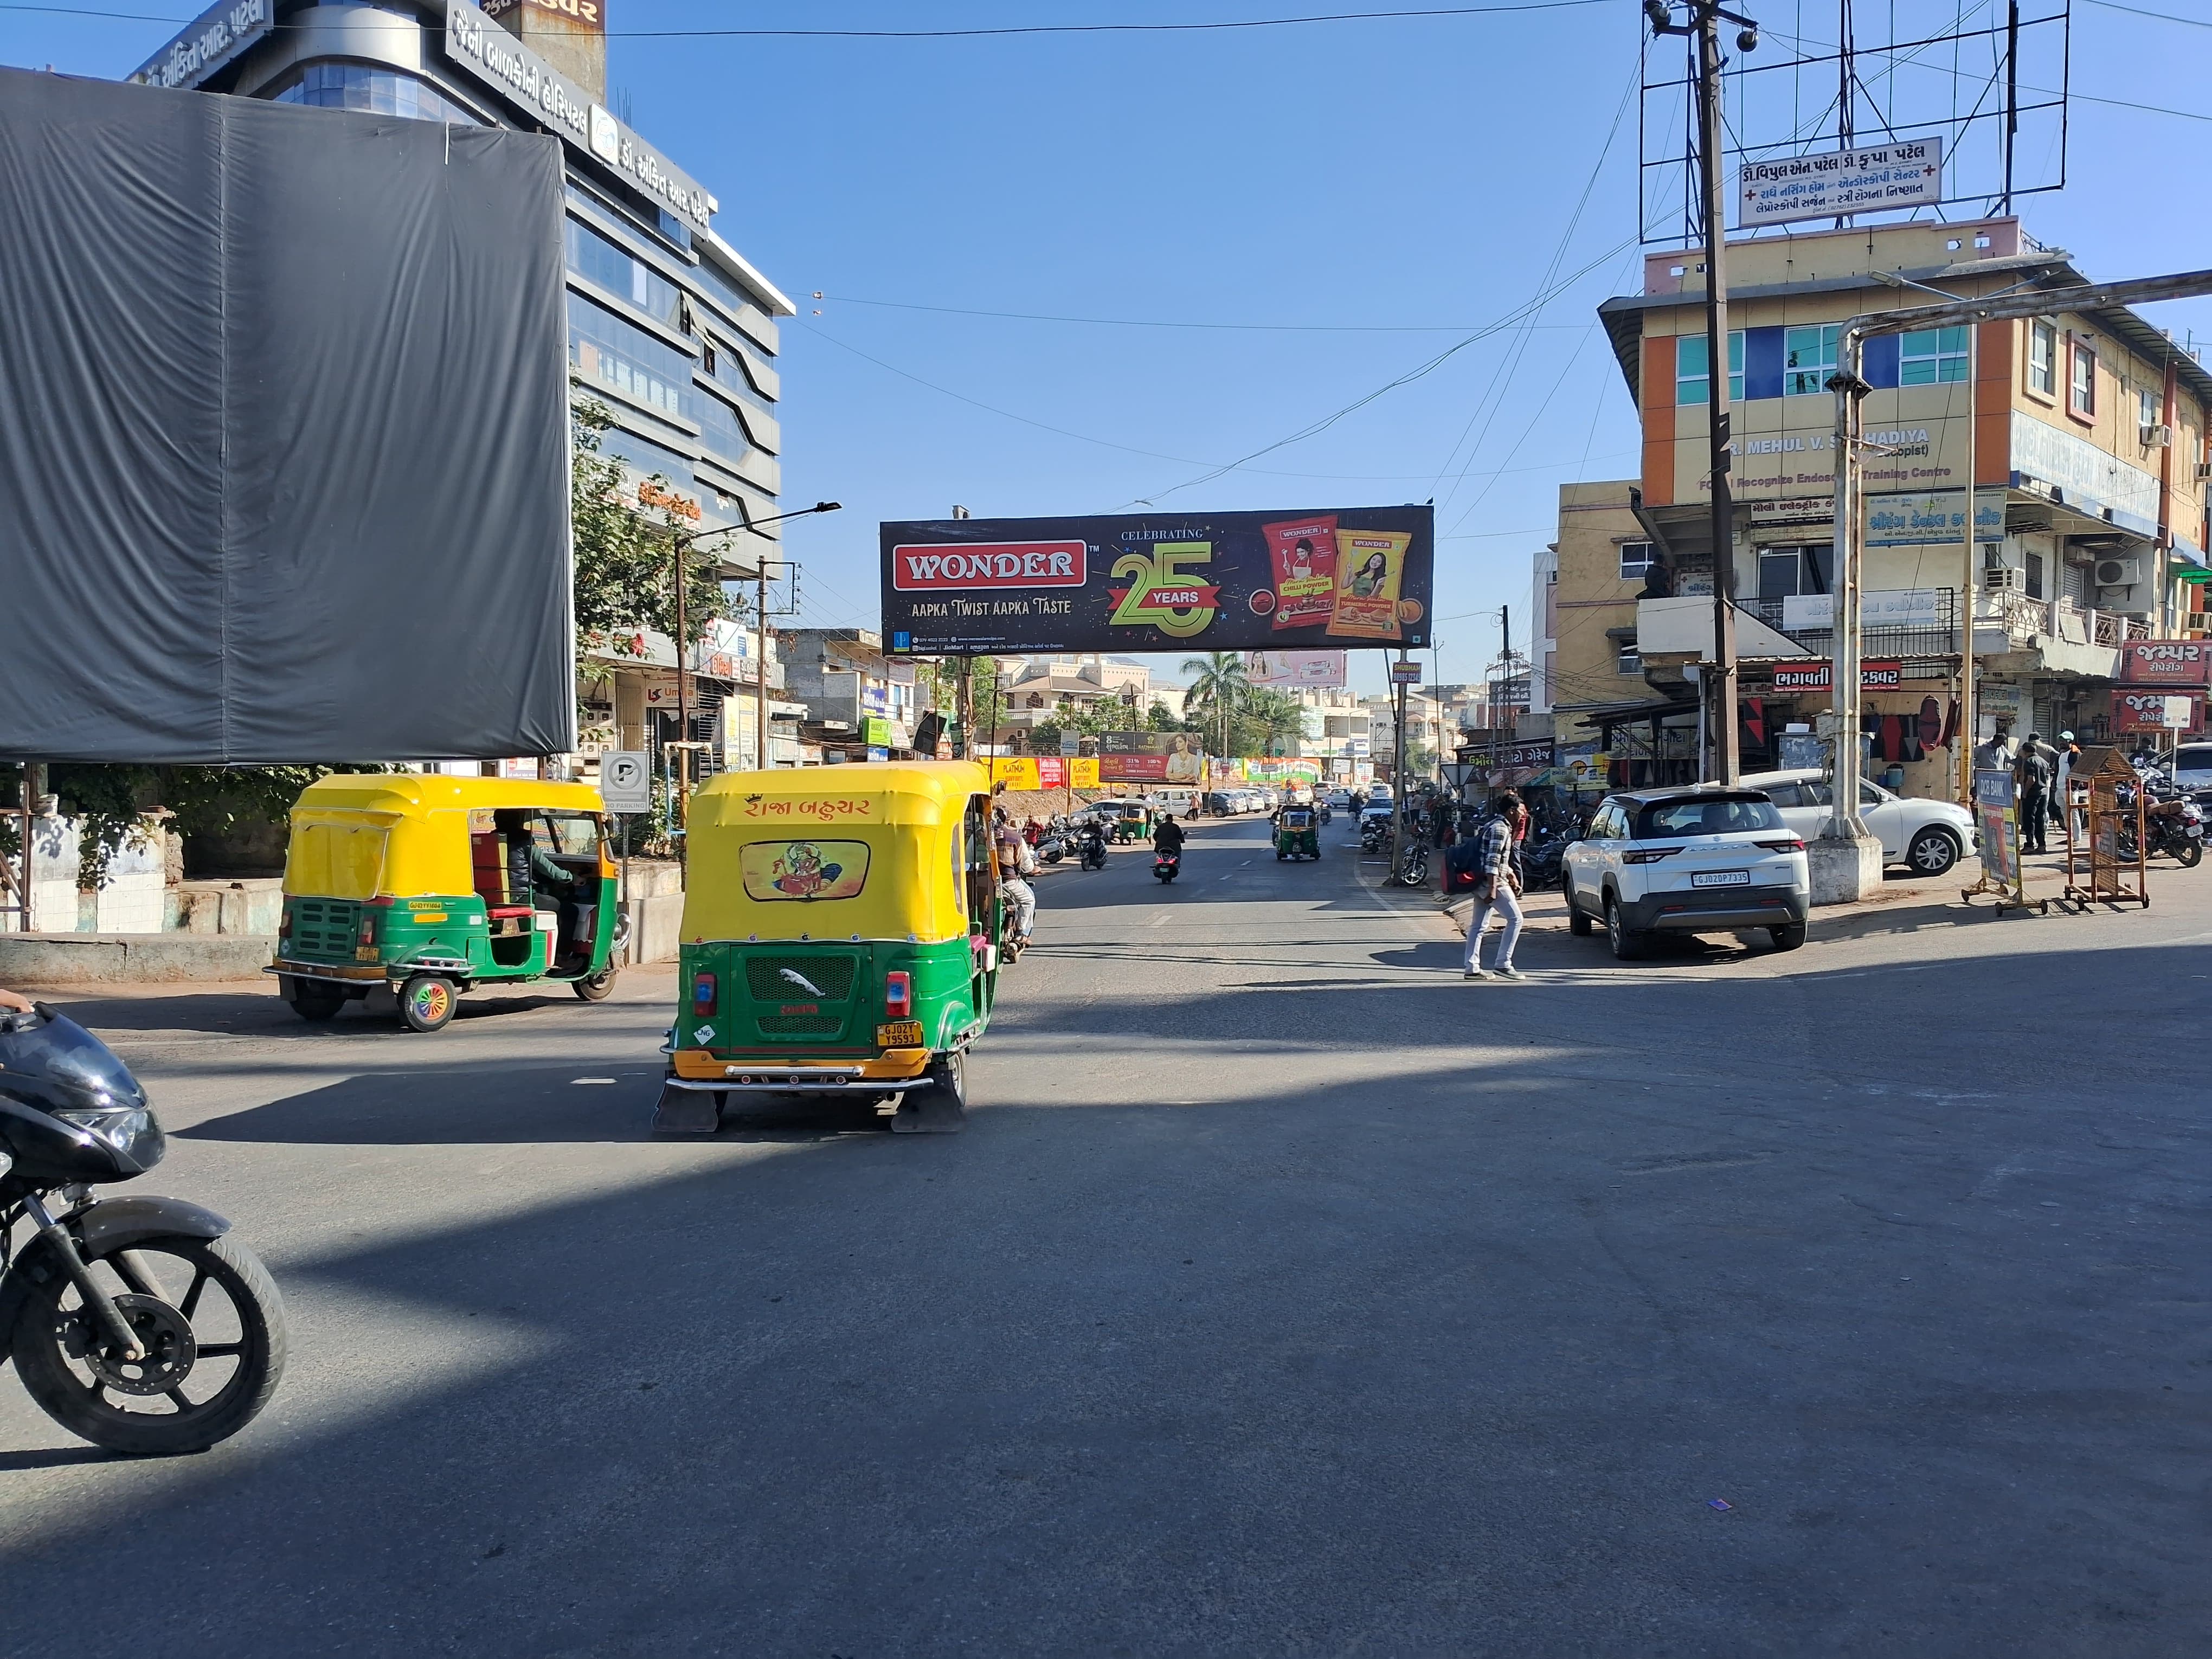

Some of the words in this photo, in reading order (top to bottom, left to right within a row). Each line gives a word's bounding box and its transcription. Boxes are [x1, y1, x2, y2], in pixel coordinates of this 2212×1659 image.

[487, 42, 539, 100] બાળકોની
[1895, 144, 1925, 160] પટેલ
[1814, 156, 1838, 171] પટેલ
[1809, 181, 1824, 191] હોમ
[1747, 438, 1805, 455] MEHUL
[1810, 436, 1824, 449] V.
[1737, 476, 1793, 490] Recognize
[1862, 468, 1908, 481] Training
[1911, 467, 1951, 478] Centre
[1121, 529, 1203, 541] CELEBRATING
[1283, 528, 1319, 538] WONDER
[1355, 540, 1390, 548] WONDER
[905, 551, 1075, 580] WONDER
[1109, 542, 1215, 637] 25
[1303, 581, 1329, 589] POWDER
[1153, 591, 1198, 603] YEARS
[911, 603, 948, 617] AAPKA
[993, 600, 1029, 616] AAPKA
[1033, 597, 1071, 614] TASTE
[2137, 645, 2200, 661] જમ્પર
[1776, 667, 1829, 685] ભગવતી
[1003, 765, 1025, 773] PLATINUM
[1073, 765, 1091, 773] PLATINUM
[1980, 779, 1990, 795] DCB
[1991, 780, 2005, 798] BANK
[1698, 873, 1747, 884] GJ02DP7335
[885, 1024, 914, 1034] GJ02Y
[886, 1034, 915, 1044] Y9593
